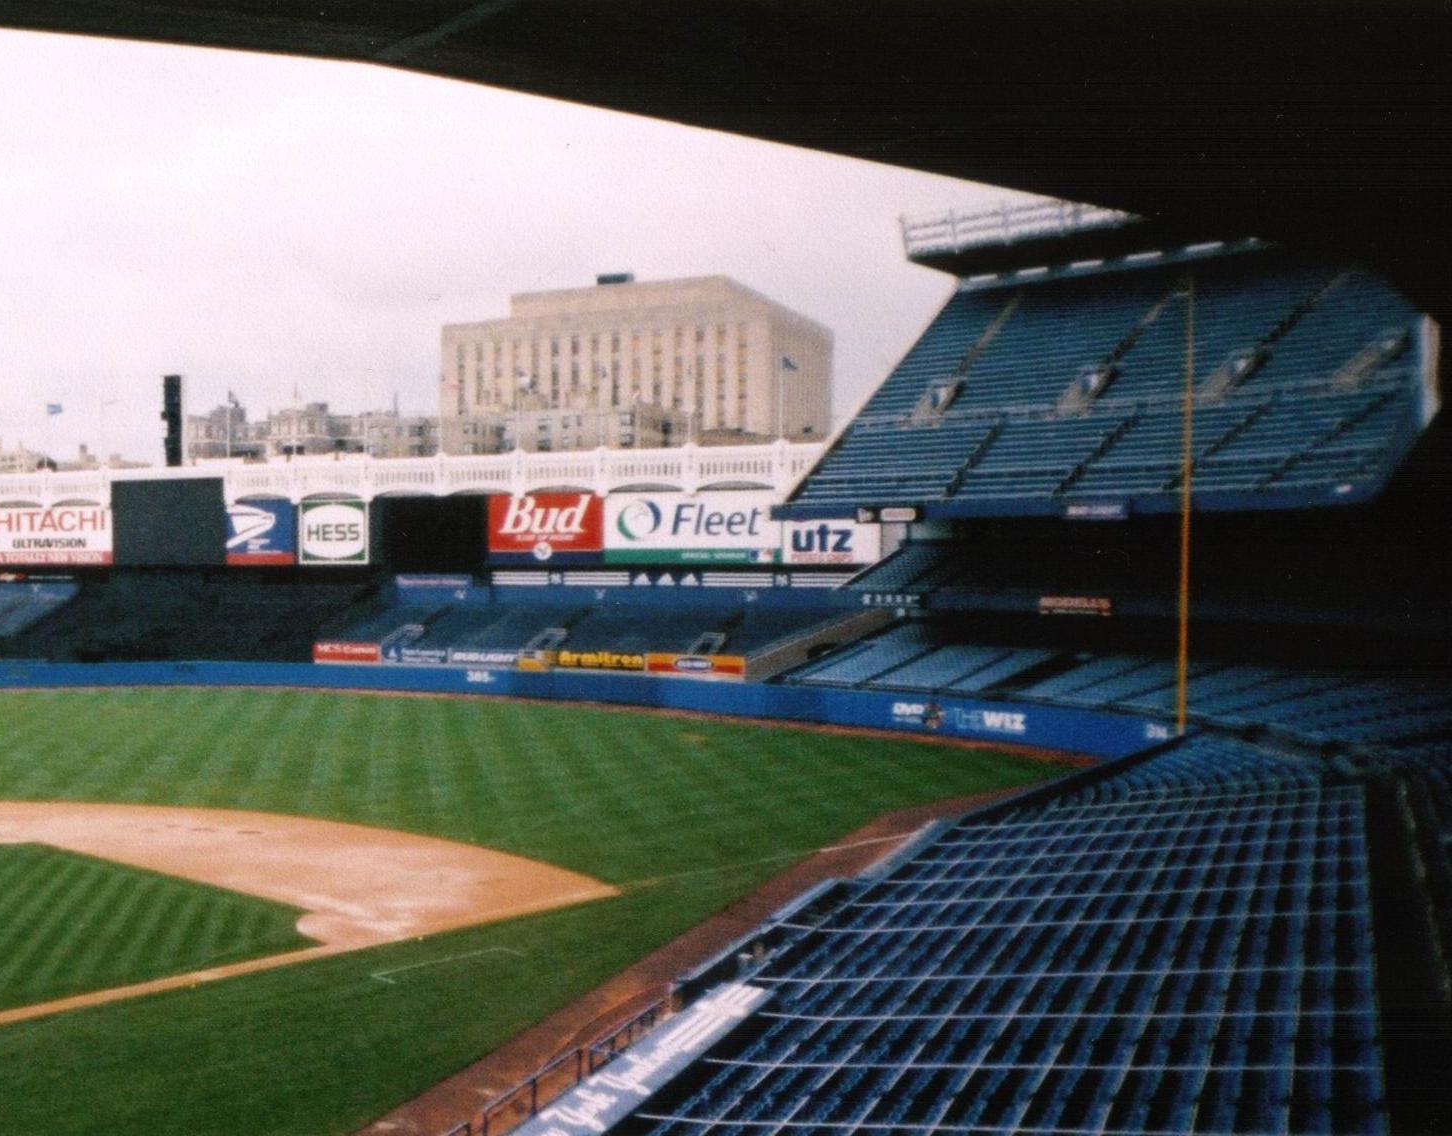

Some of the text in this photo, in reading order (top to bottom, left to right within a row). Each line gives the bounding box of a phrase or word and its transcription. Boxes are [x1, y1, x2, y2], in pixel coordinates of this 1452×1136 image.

[497, 494, 593, 534] Bud
[671, 503, 762, 536] Fleet
[307, 523, 360, 542] HESS
[792, 523, 853, 552] utz
[12, 538, 87, 549] ULTRAVISION
[558, 651, 644, 667] Armitron
[982, 711, 1025, 731] WIZ
